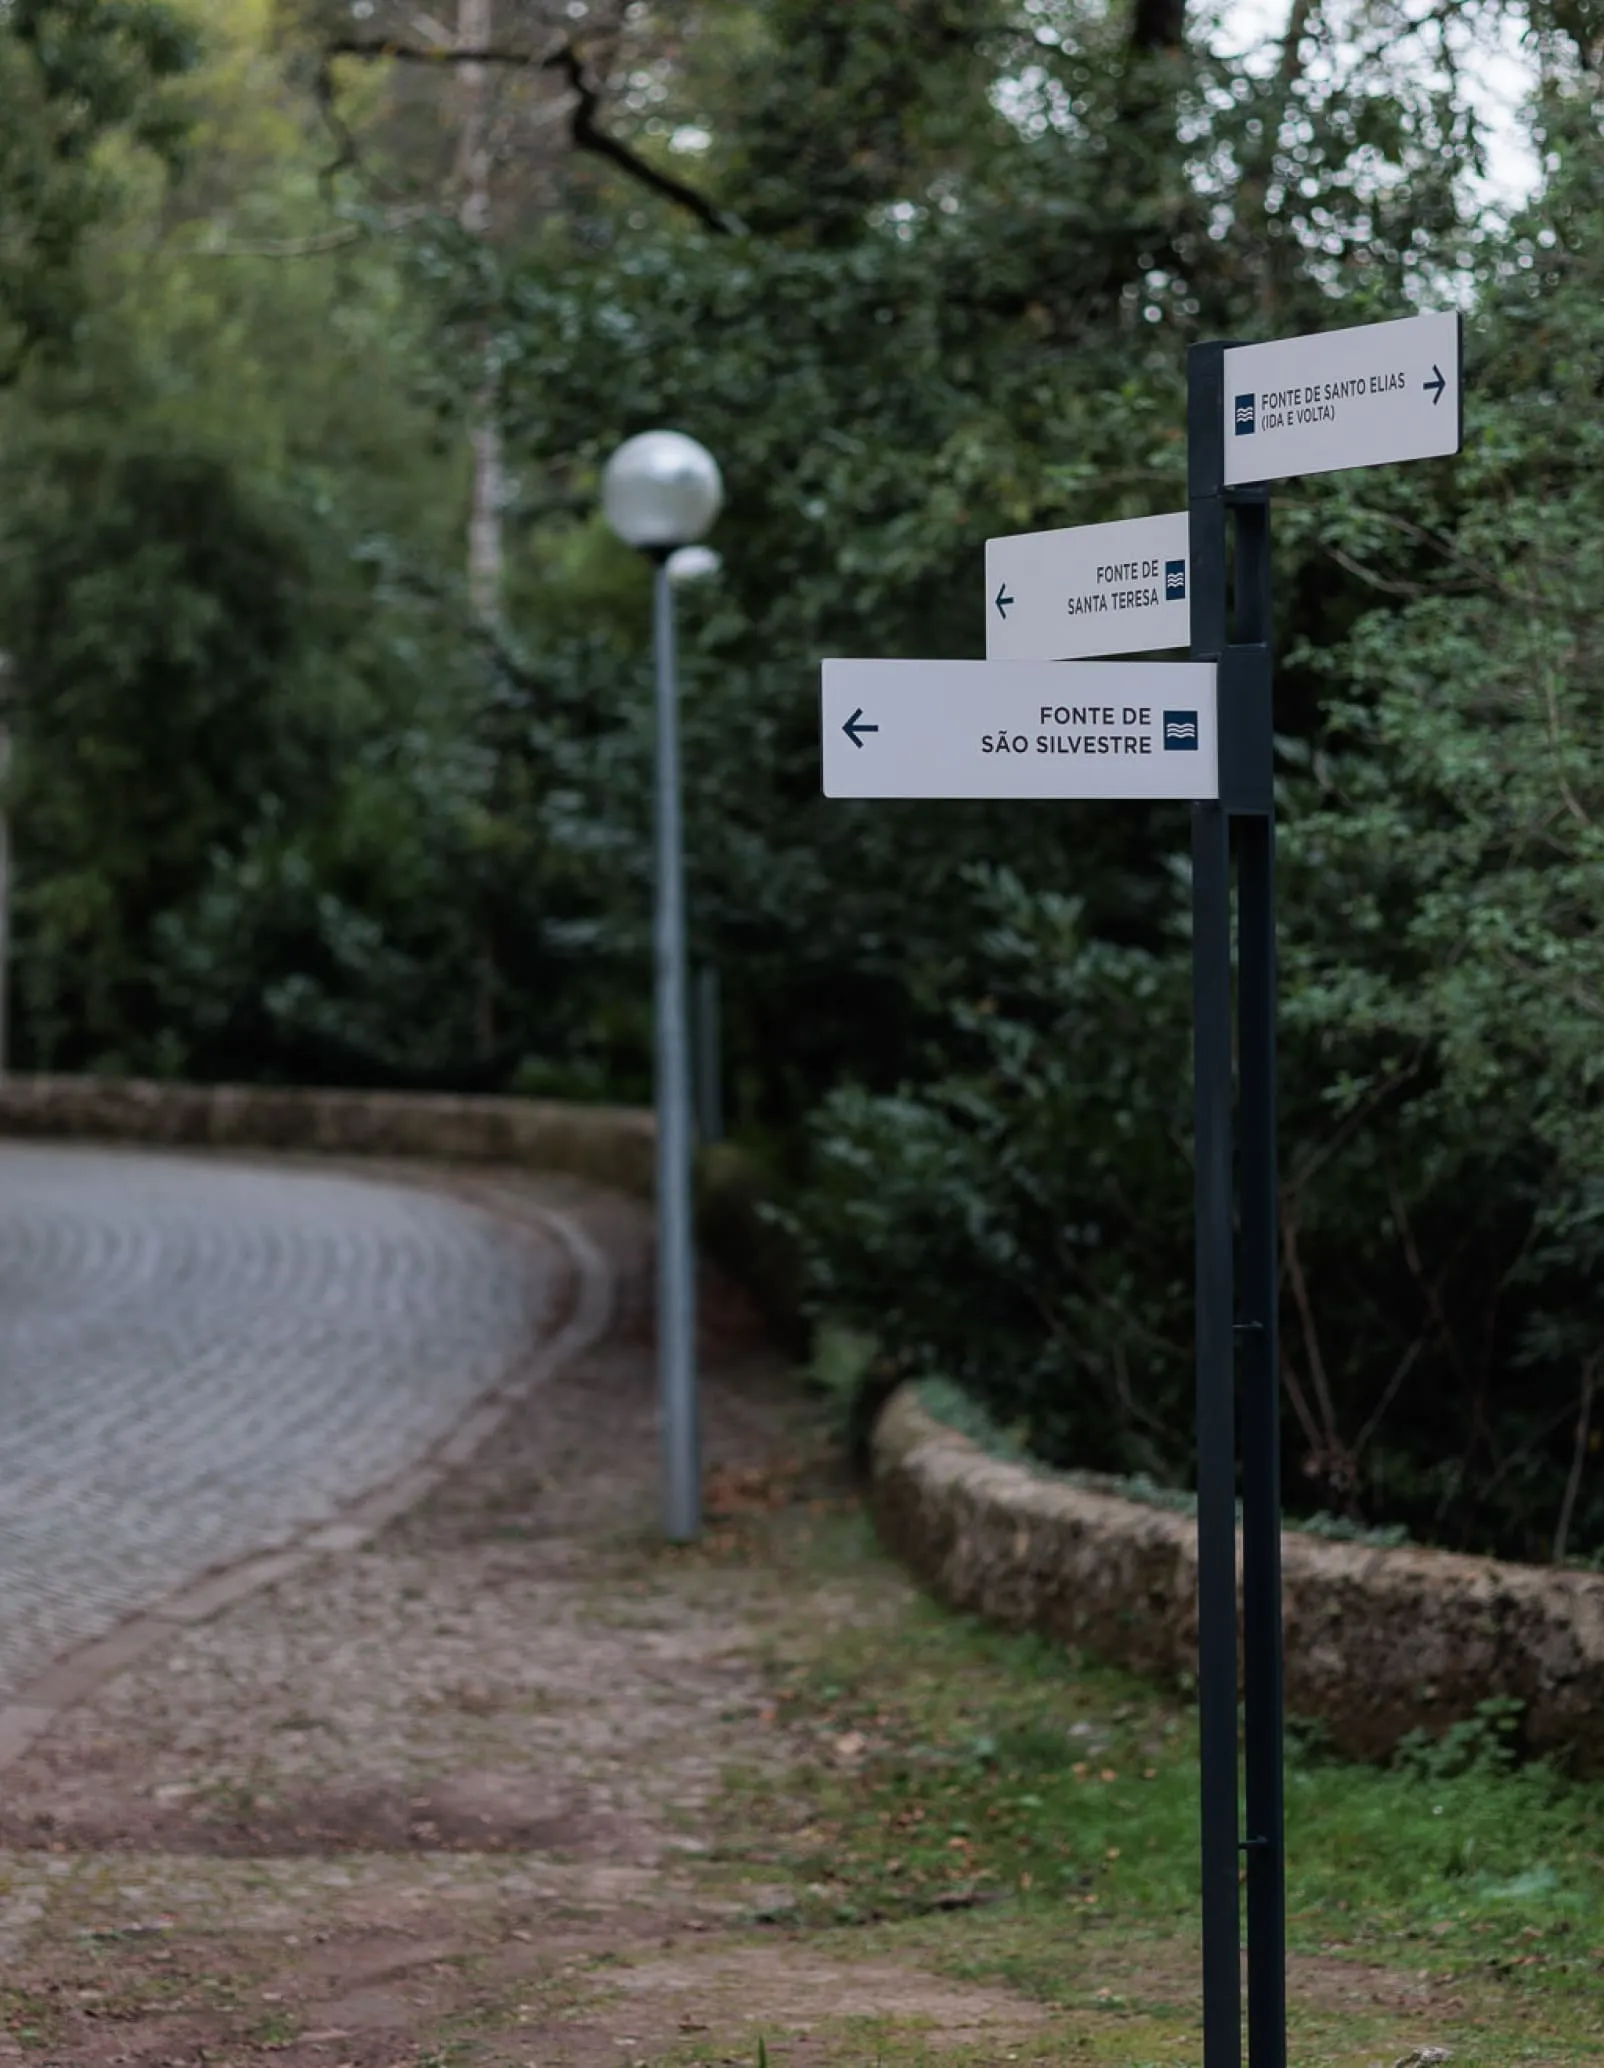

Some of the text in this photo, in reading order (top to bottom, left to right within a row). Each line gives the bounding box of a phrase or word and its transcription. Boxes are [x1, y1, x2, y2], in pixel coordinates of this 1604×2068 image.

[1261, 372, 1405, 411] FONTE DE SANTO ELIAS
[1261, 404, 1335, 431] (IDA E VOLTA)
[1096, 560, 1159, 584] FONTE DE
[1067, 587, 1159, 615] SANTA TERESA
[1040, 707, 1152, 725] FONTE DE
[981, 731, 1152, 754] SÃO SILVESTRE
